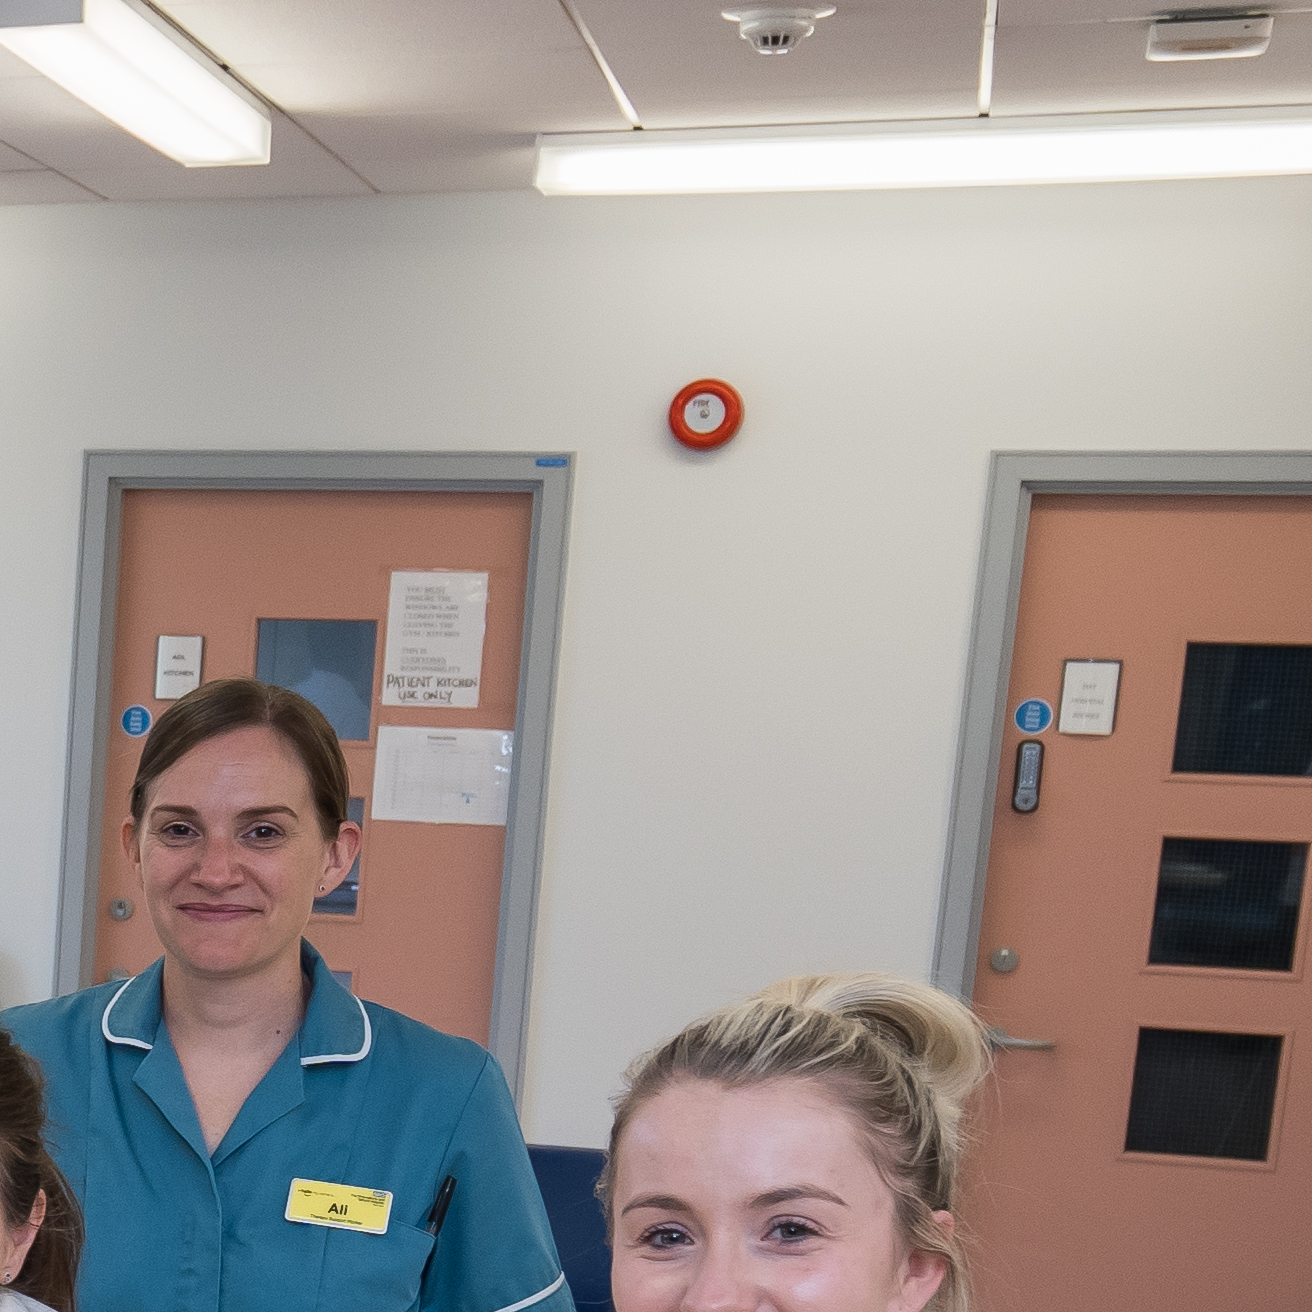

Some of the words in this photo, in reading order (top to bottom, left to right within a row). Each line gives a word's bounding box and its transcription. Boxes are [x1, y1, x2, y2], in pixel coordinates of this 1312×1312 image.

[386, 674, 433, 688] PATIENT
[436, 677, 477, 688] KITCHEN
[398, 690, 418, 700] USE
[422, 689, 453, 703] ONLY
[327, 1203, 349, 1216] Ali
